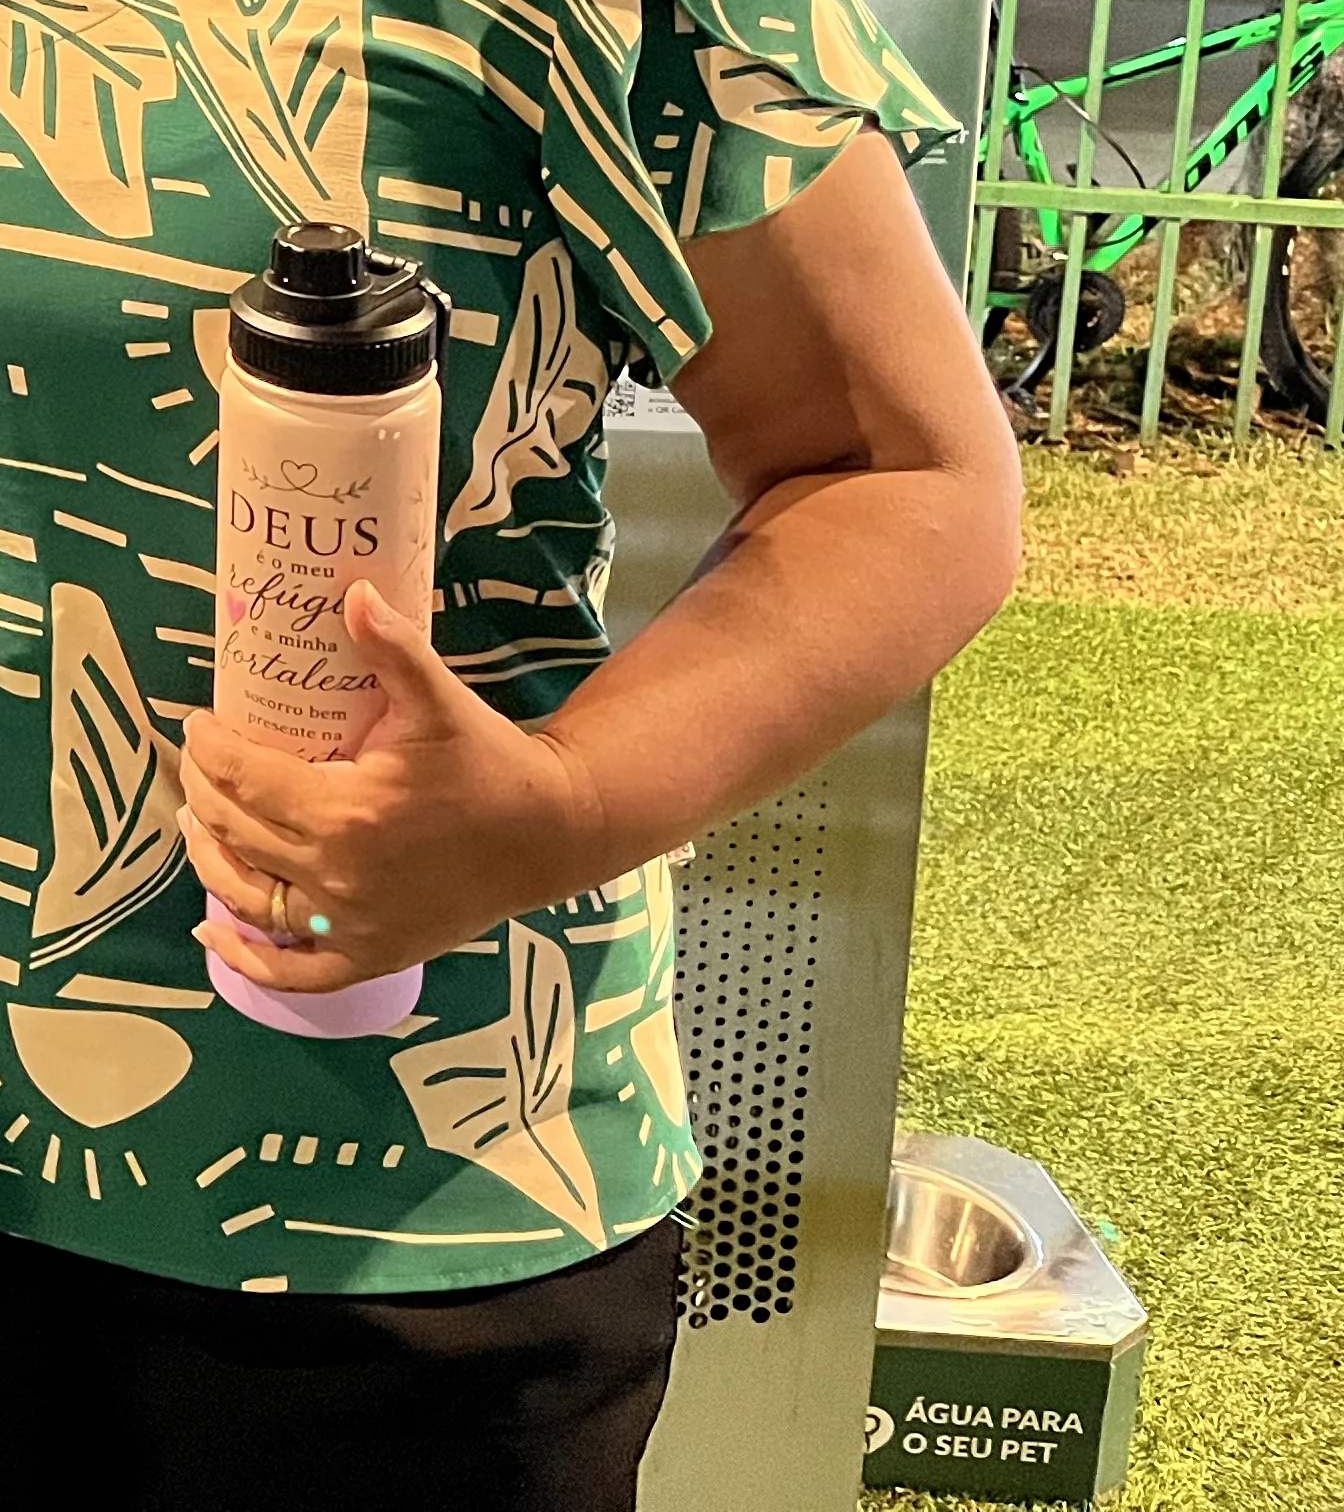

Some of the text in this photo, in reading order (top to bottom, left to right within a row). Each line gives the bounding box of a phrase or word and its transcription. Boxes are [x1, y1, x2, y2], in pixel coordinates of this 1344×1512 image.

[230, 489, 379, 557] DEUS
[271, 557, 283, 570] o
[290, 561, 336, 579] meu
[229, 563, 345, 633] refúgi
[250, 624, 338, 654] e a minha
[219, 629, 379, 692] fortaleza
[243, 688, 348, 722] socorro bem
[247, 710, 344, 742] presente na
[904, 1395, 1085, 1435] ÁGUA PARA
[902, 1431, 1059, 1465] O SEU PET
